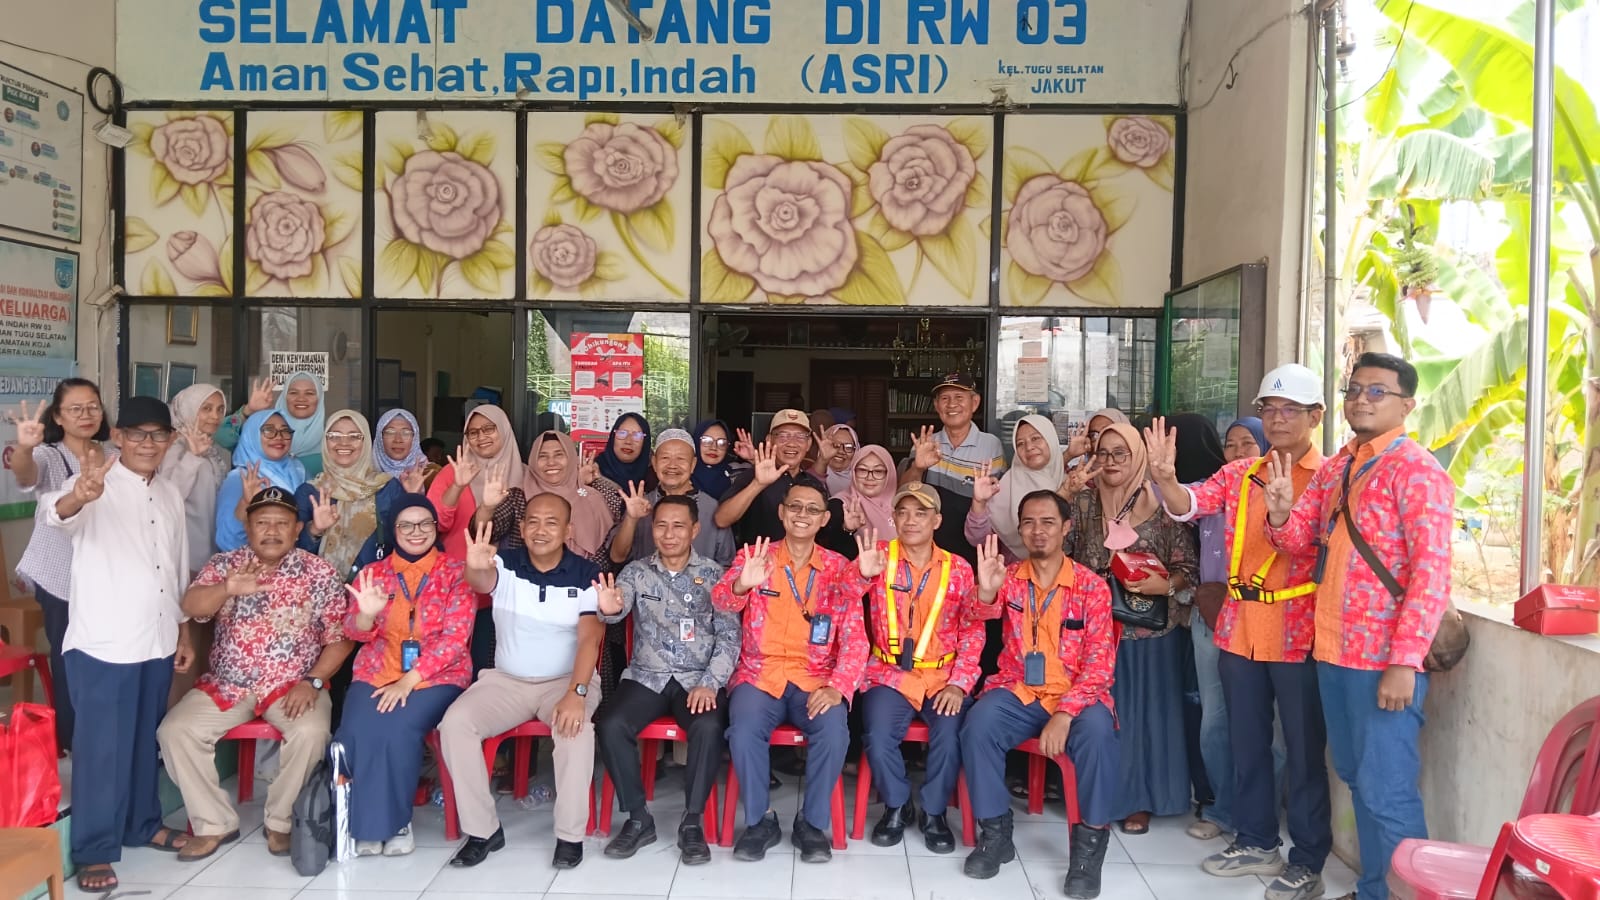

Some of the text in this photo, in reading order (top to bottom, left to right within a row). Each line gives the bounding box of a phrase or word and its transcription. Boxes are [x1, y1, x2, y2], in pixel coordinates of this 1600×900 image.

[199, 0, 1087, 44] SELAMAT DATANG DI RW 03
[200, 52, 327, 91] Aman
[801, 53, 948, 94] (ASRI)
[1056, 65, 1104, 74] SELATAN
[1031, 78, 1087, 94] JAKUT
[36, 332, 67, 341] SELATAN
[272, 354, 286, 363] DEMI
